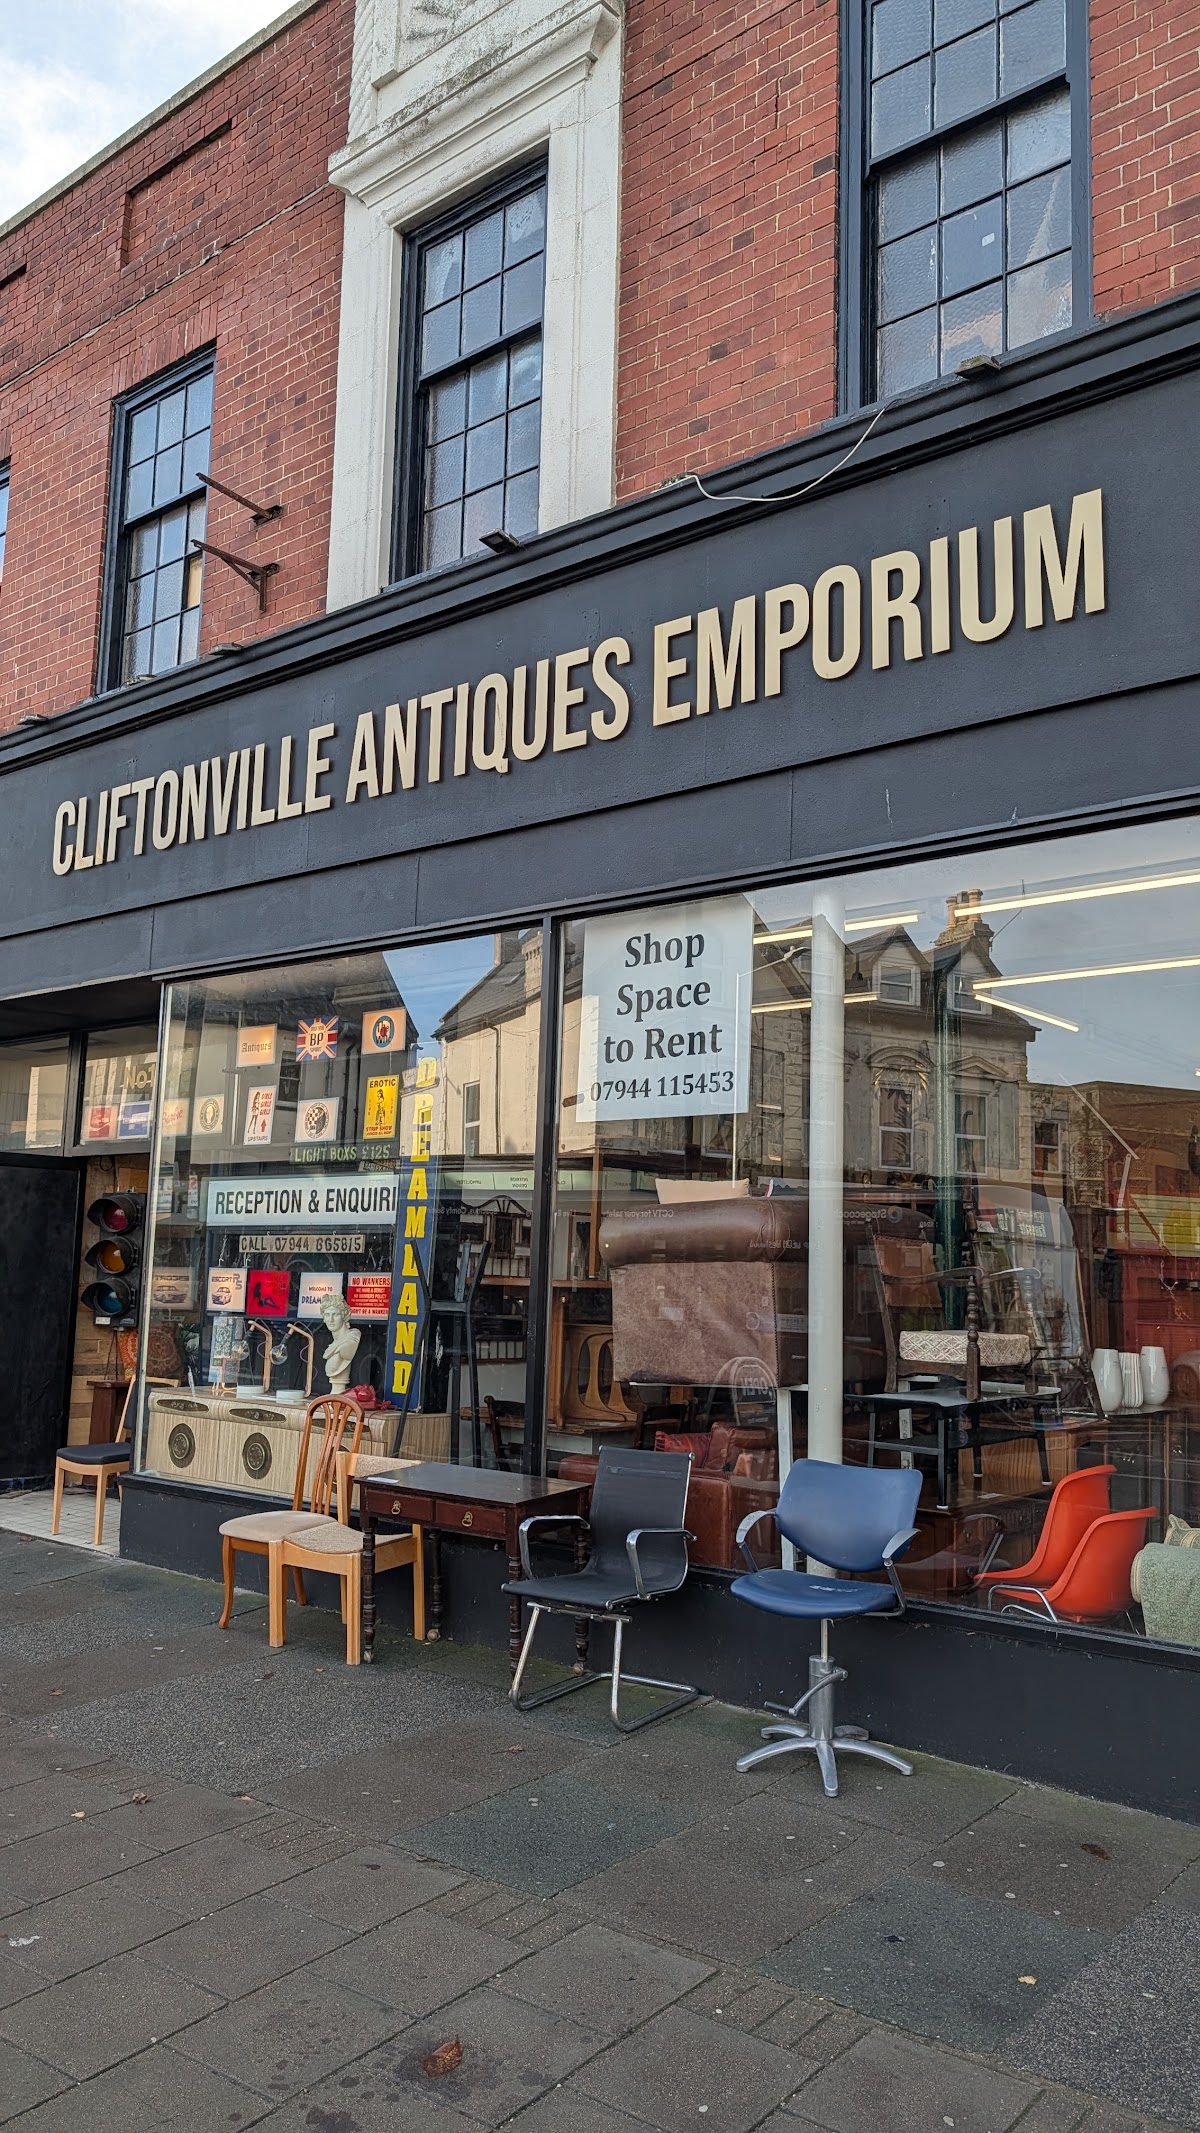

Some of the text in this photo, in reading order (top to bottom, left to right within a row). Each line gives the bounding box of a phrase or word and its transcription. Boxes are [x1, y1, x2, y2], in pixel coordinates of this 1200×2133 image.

[52, 488, 1106, 876] CLIFTONVILLE ANTIQUES EMPORIUM
[624, 932, 705, 969] Shop
[616, 981, 711, 1023] Space
[309, 1032, 324, 1046] BP
[603, 1023, 723, 1064] to Rent
[241, 1041, 273, 1053] Antiques
[369, 1078, 396, 1088] EROTIC
[590, 1070, 734, 1102] 07944 115453
[261, 1092, 273, 1100] GIRLS
[260, 1100, 272, 1108] GIRLS
[259, 1108, 271, 1116] GIRLS
[294, 1144, 391, 1163] LIGHT BOXS £125
[215, 1189, 302, 1214] RECEPTION
[308, 1189, 320, 1213] &
[325, 1186, 397, 1213] ENQUIRI
[392, 1056, 437, 1394] DREAMLAND
[241, 1237, 268, 1251] CALL
[274, 1236, 310, 1251] 07944
[352, 1277, 391, 1286] NO WANKERS
[301, 1295, 321, 1305] DREAM
